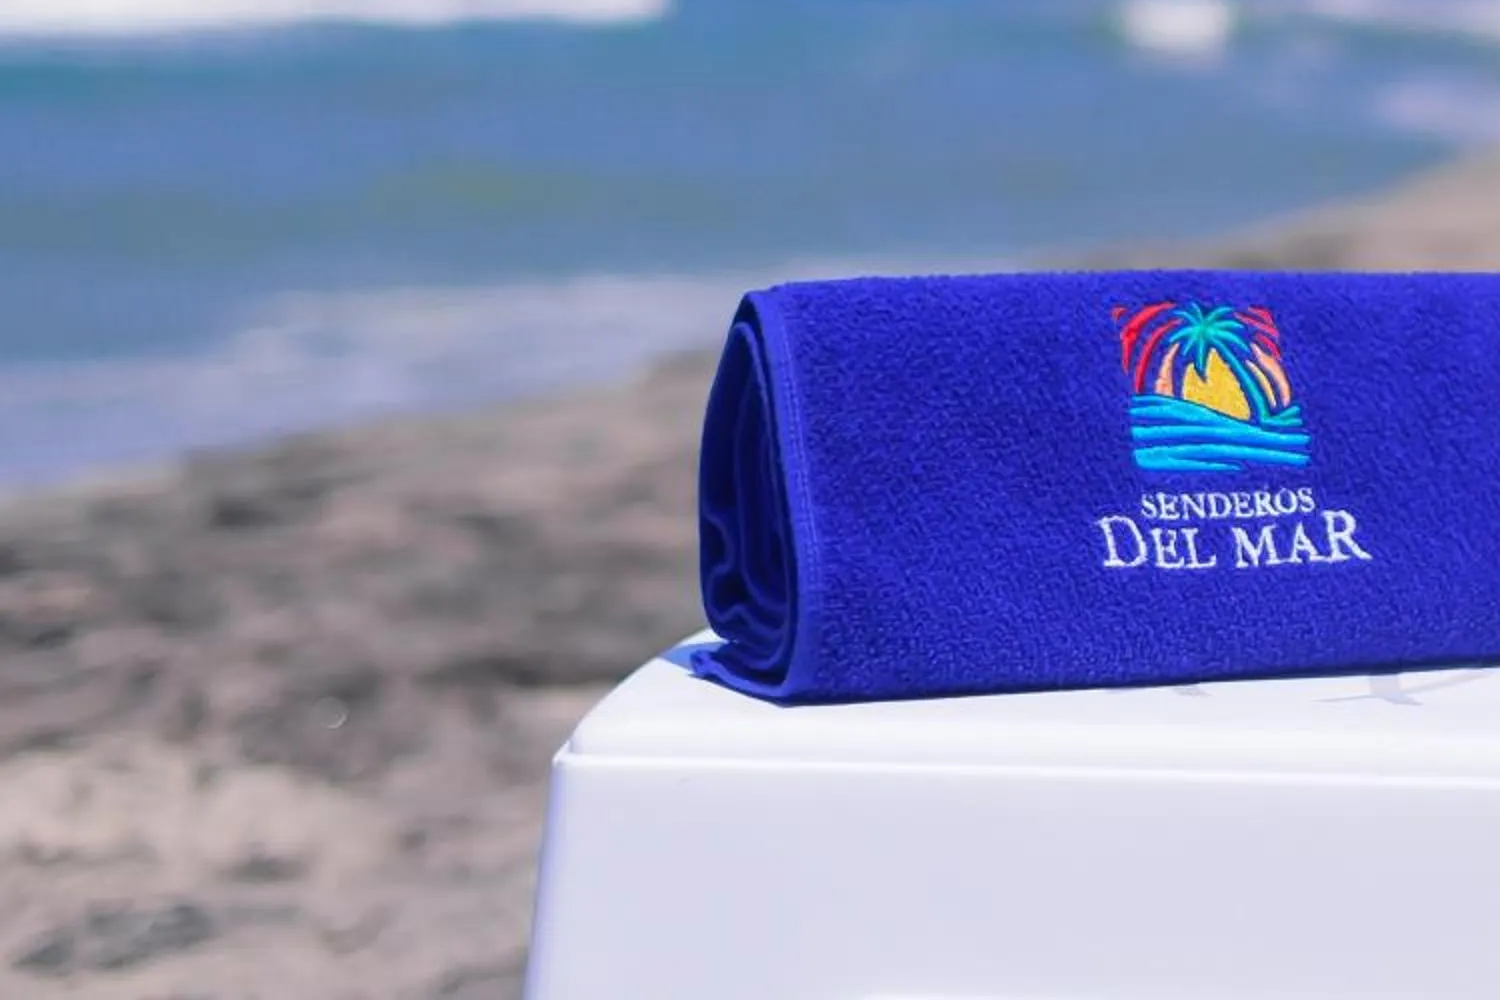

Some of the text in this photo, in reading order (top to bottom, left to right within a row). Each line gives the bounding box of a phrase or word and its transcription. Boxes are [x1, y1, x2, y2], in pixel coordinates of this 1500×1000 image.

[1140, 487, 1316, 520] SENDEROS
[1096, 510, 1373, 569] DEL MAR
